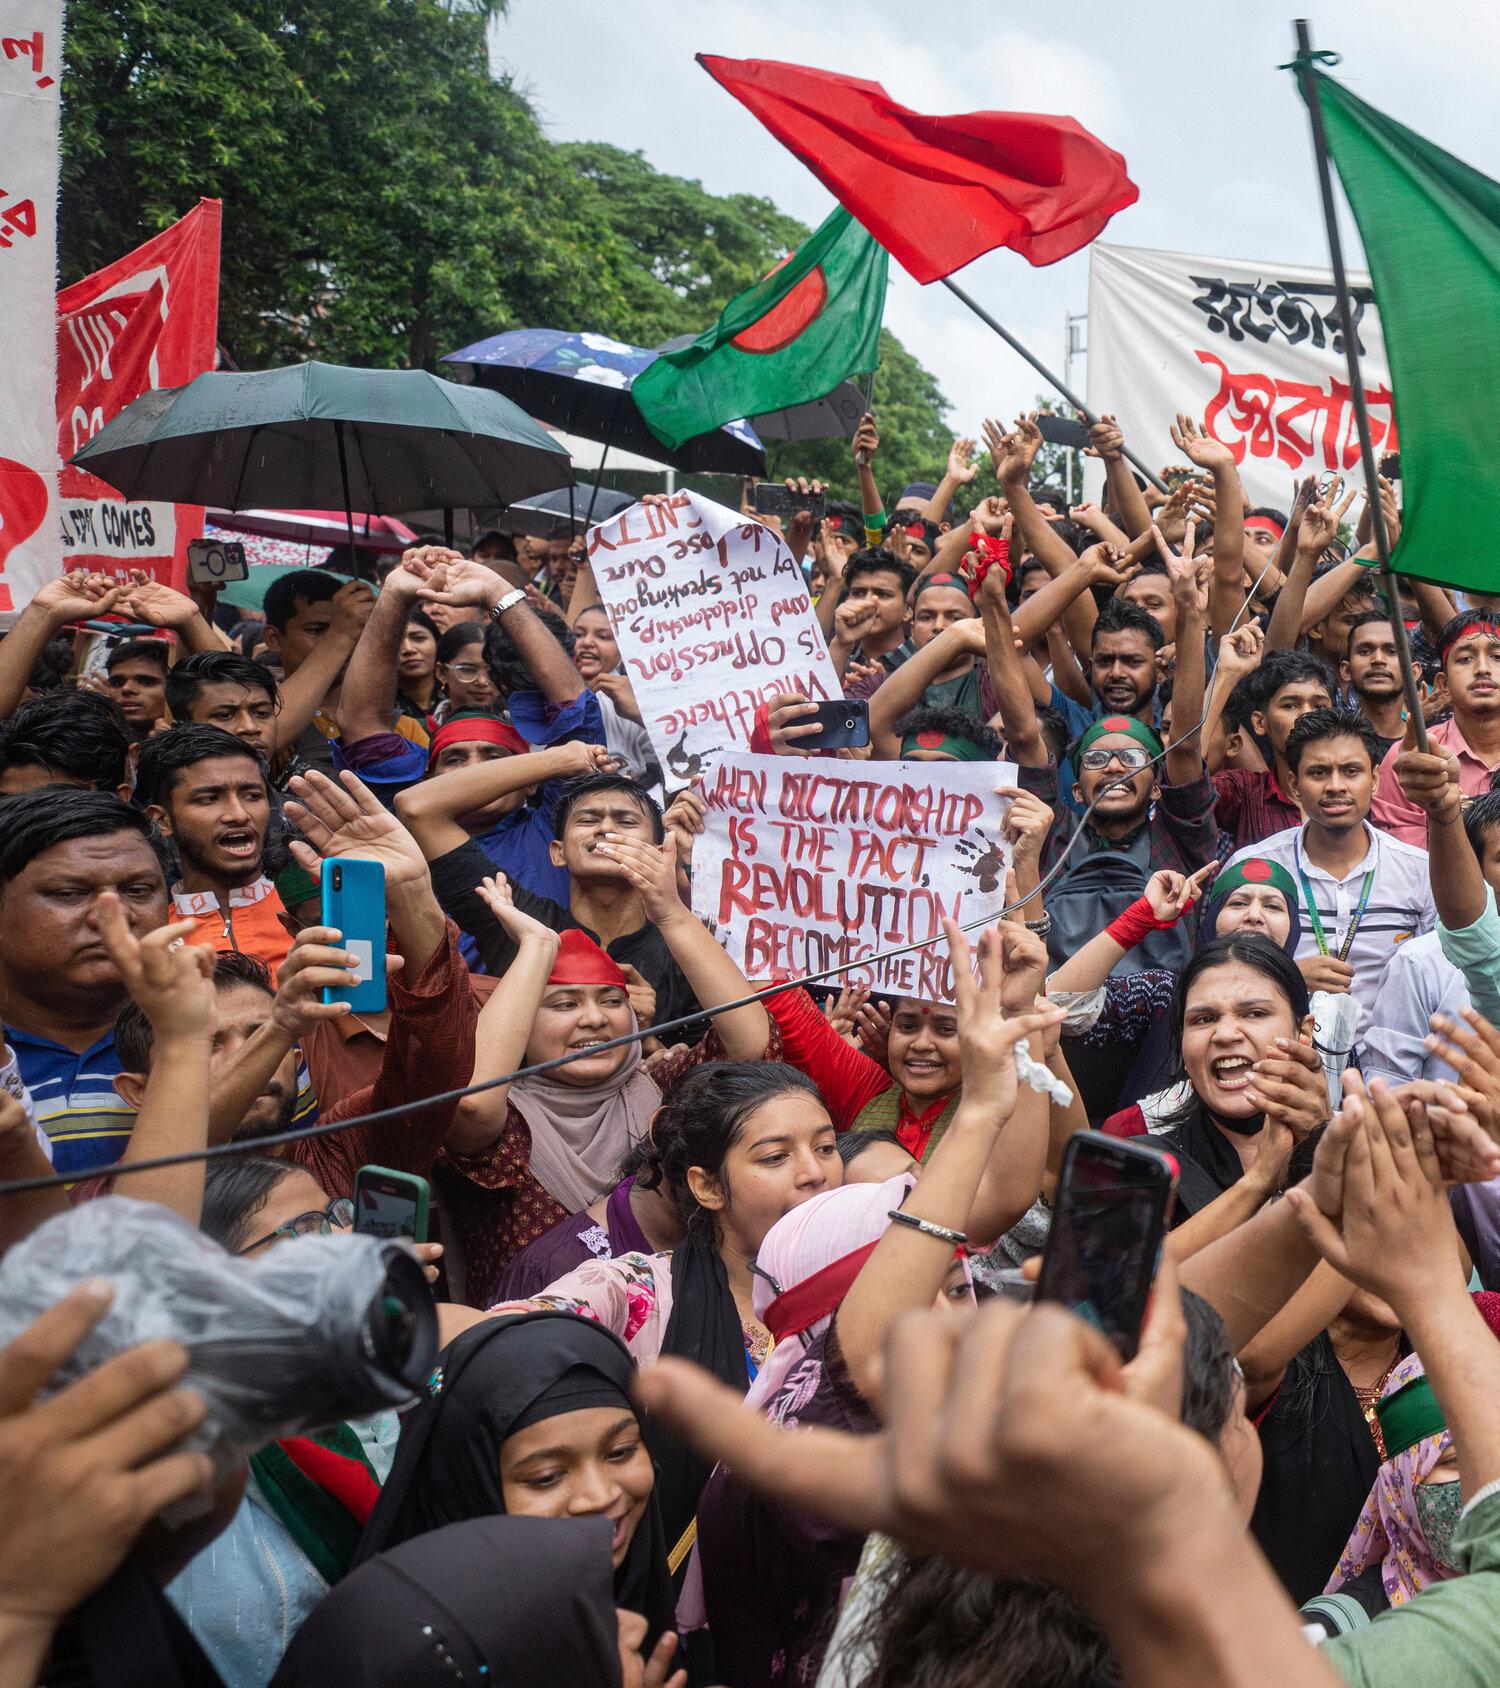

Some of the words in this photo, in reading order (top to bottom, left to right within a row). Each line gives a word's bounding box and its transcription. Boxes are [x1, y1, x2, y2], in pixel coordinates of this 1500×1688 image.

[102, 502, 156, 549] COMES
[728, 566, 767, 595] not
[773, 548, 798, 581] by
[770, 593, 810, 627] and
[700, 763, 768, 815] WHEN
[778, 771, 984, 837] DICTATORSHIP
[728, 815, 758, 860] IS
[767, 821, 839, 872] THE
[717, 857, 963, 955] REVOLUTION
[744, 917, 876, 990] BECOMES
[869, 953, 916, 991] THE
